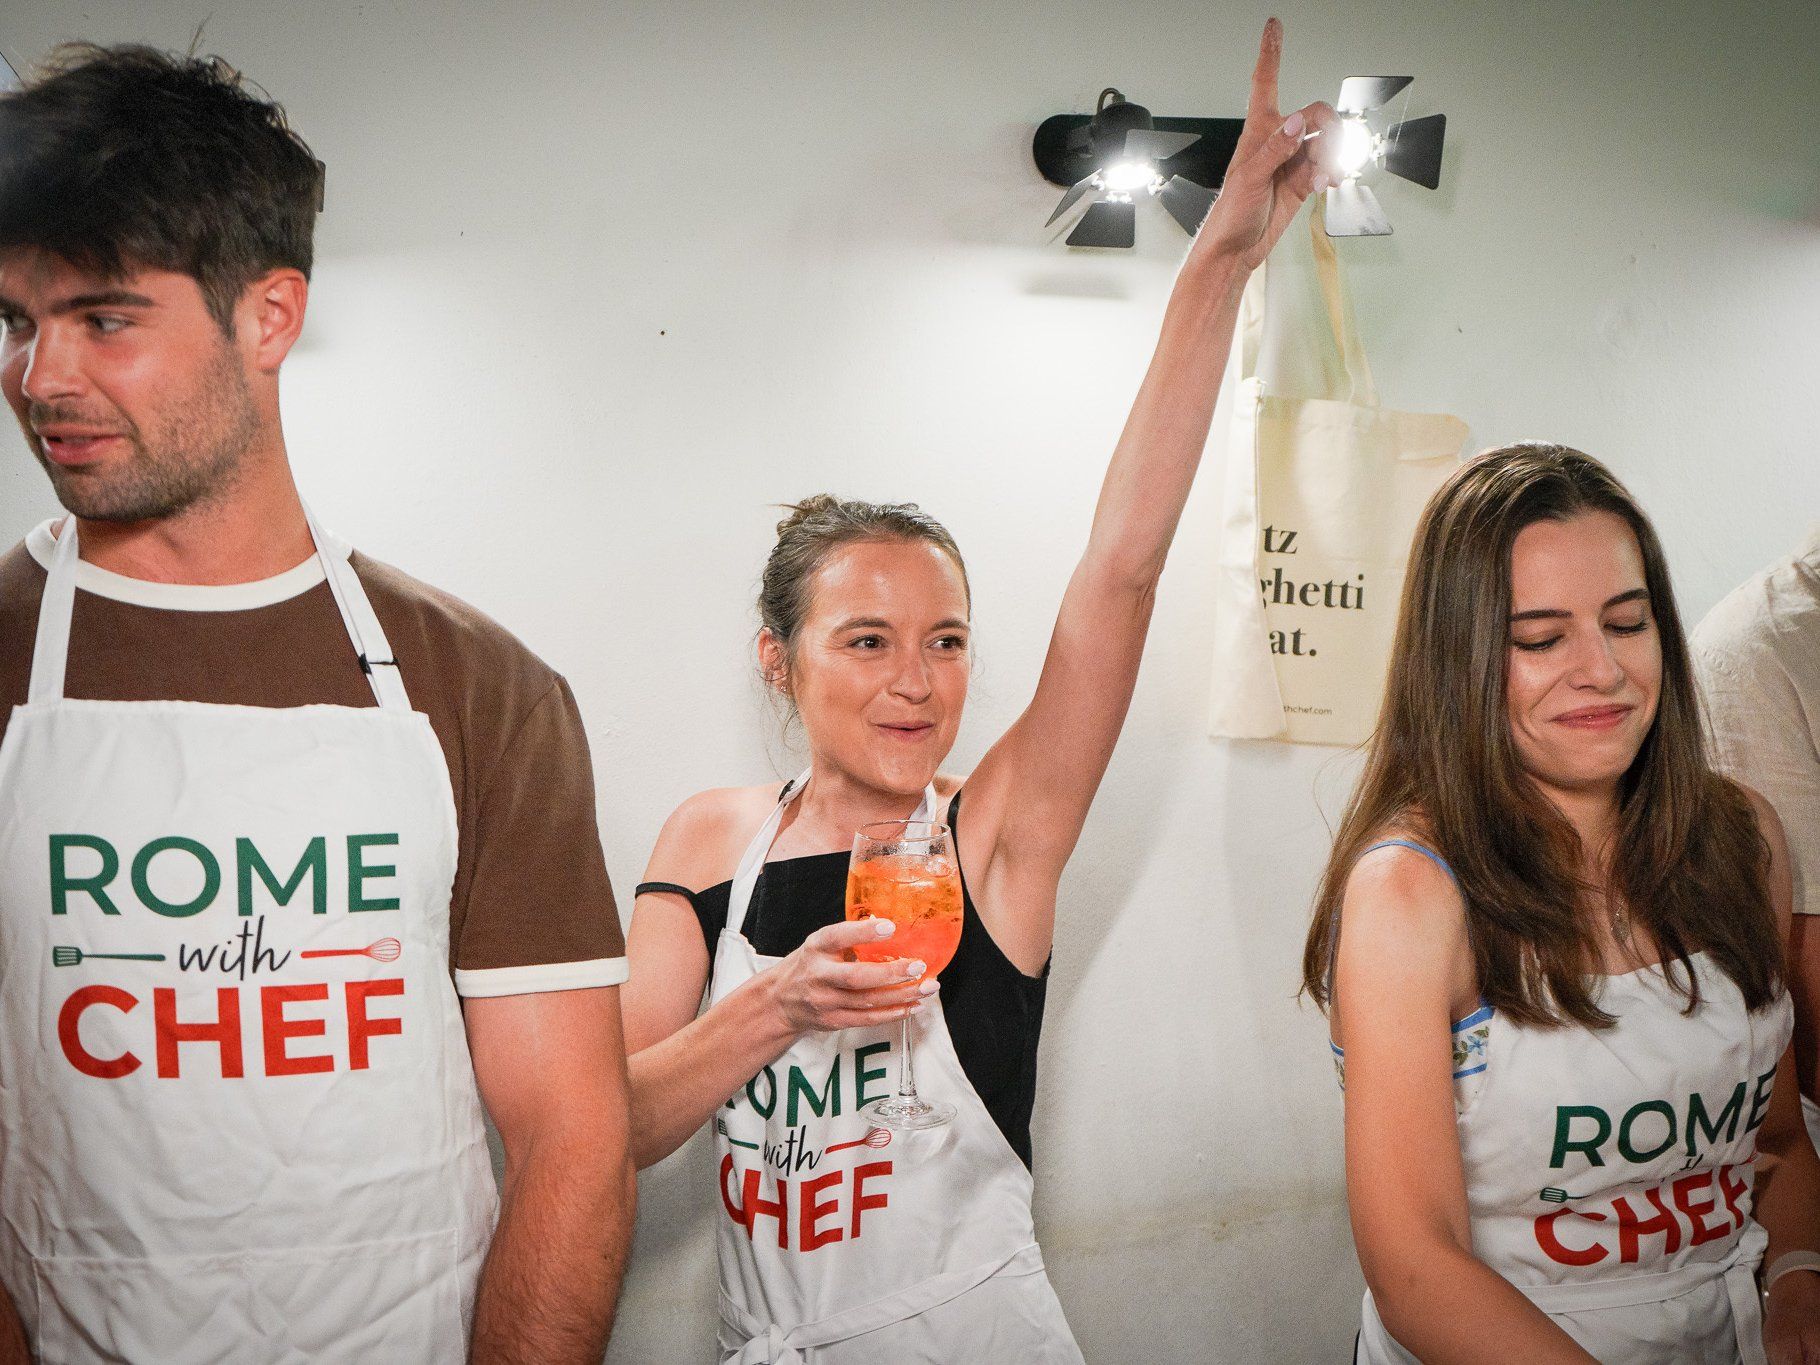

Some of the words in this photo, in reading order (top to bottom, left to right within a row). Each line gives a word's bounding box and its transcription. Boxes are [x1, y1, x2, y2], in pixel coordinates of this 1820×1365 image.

[49, 833, 400, 917] ROME
[179, 915, 291, 981] with
[58, 978, 404, 1079] CHEF
[726, 1041, 891, 1127] OME
[1549, 1062, 1777, 1169] ROME
[763, 1125, 822, 1177] with
[720, 1153, 893, 1252] CHEF
[1534, 1162, 1748, 1266] CHEF
